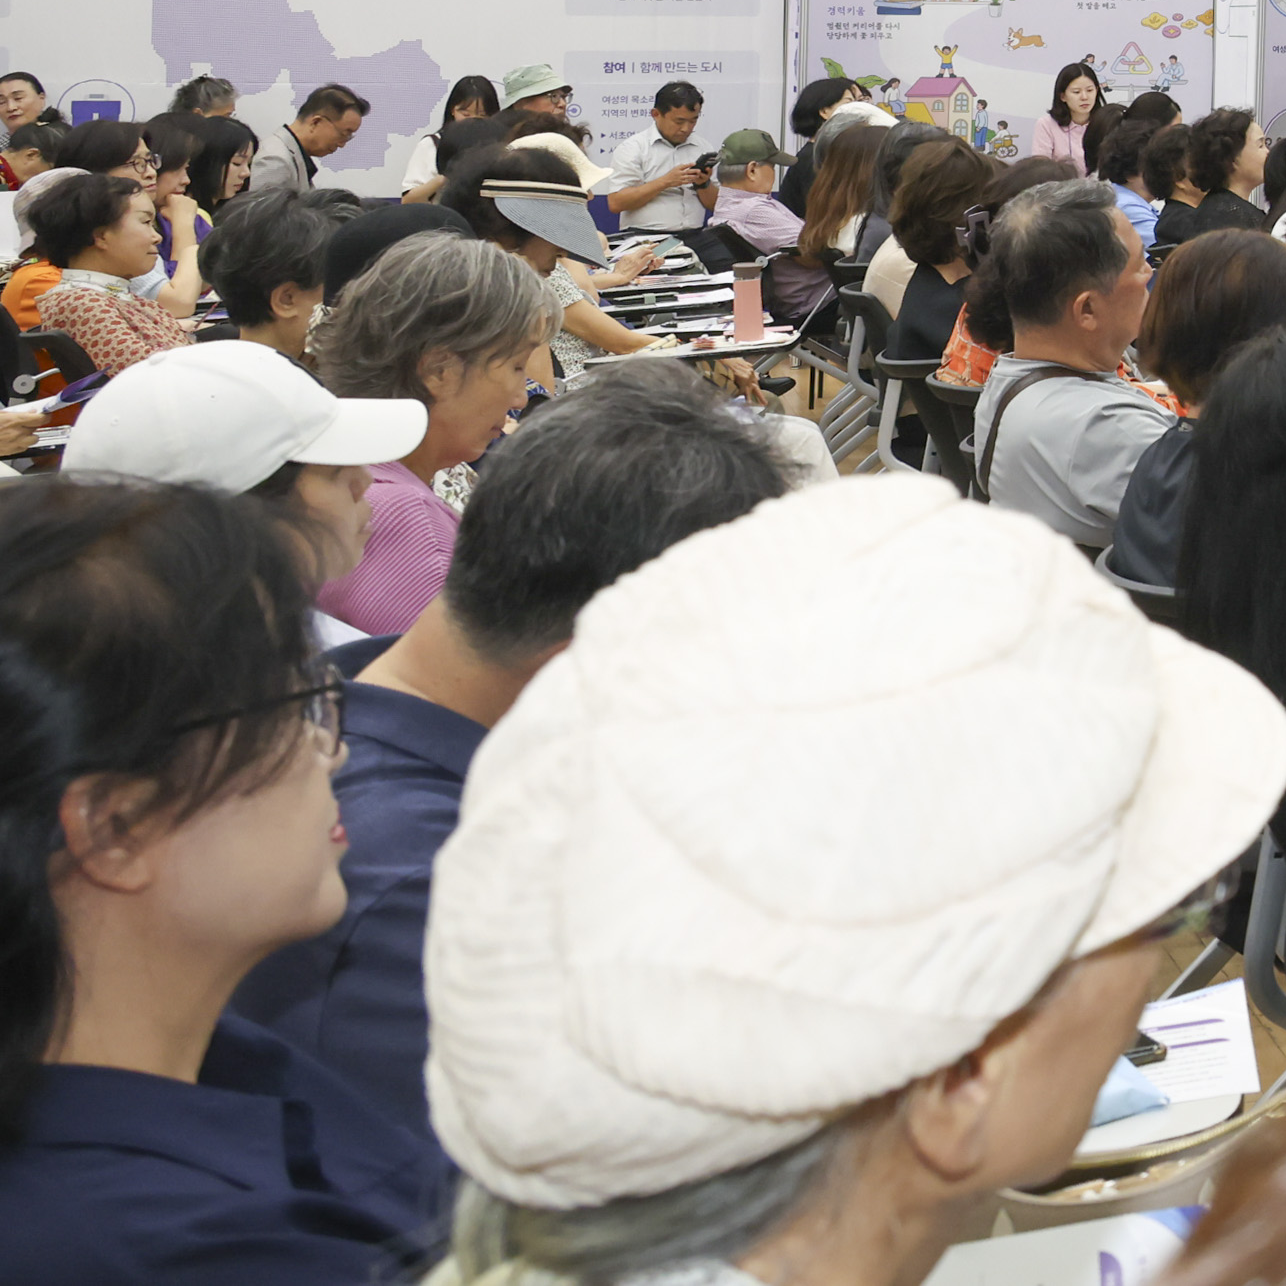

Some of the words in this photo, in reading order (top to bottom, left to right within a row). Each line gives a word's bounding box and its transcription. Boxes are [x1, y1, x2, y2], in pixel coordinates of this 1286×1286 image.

[828, 6, 865, 16] 경력키움
[603, 61, 626, 74] 참여
[640, 61, 662, 74] 함께
[664, 62, 698, 74] 만드는
[700, 62, 722, 74] 도시
[602, 95, 629, 105] 여성의
[601, 109, 628, 118] 지역의
